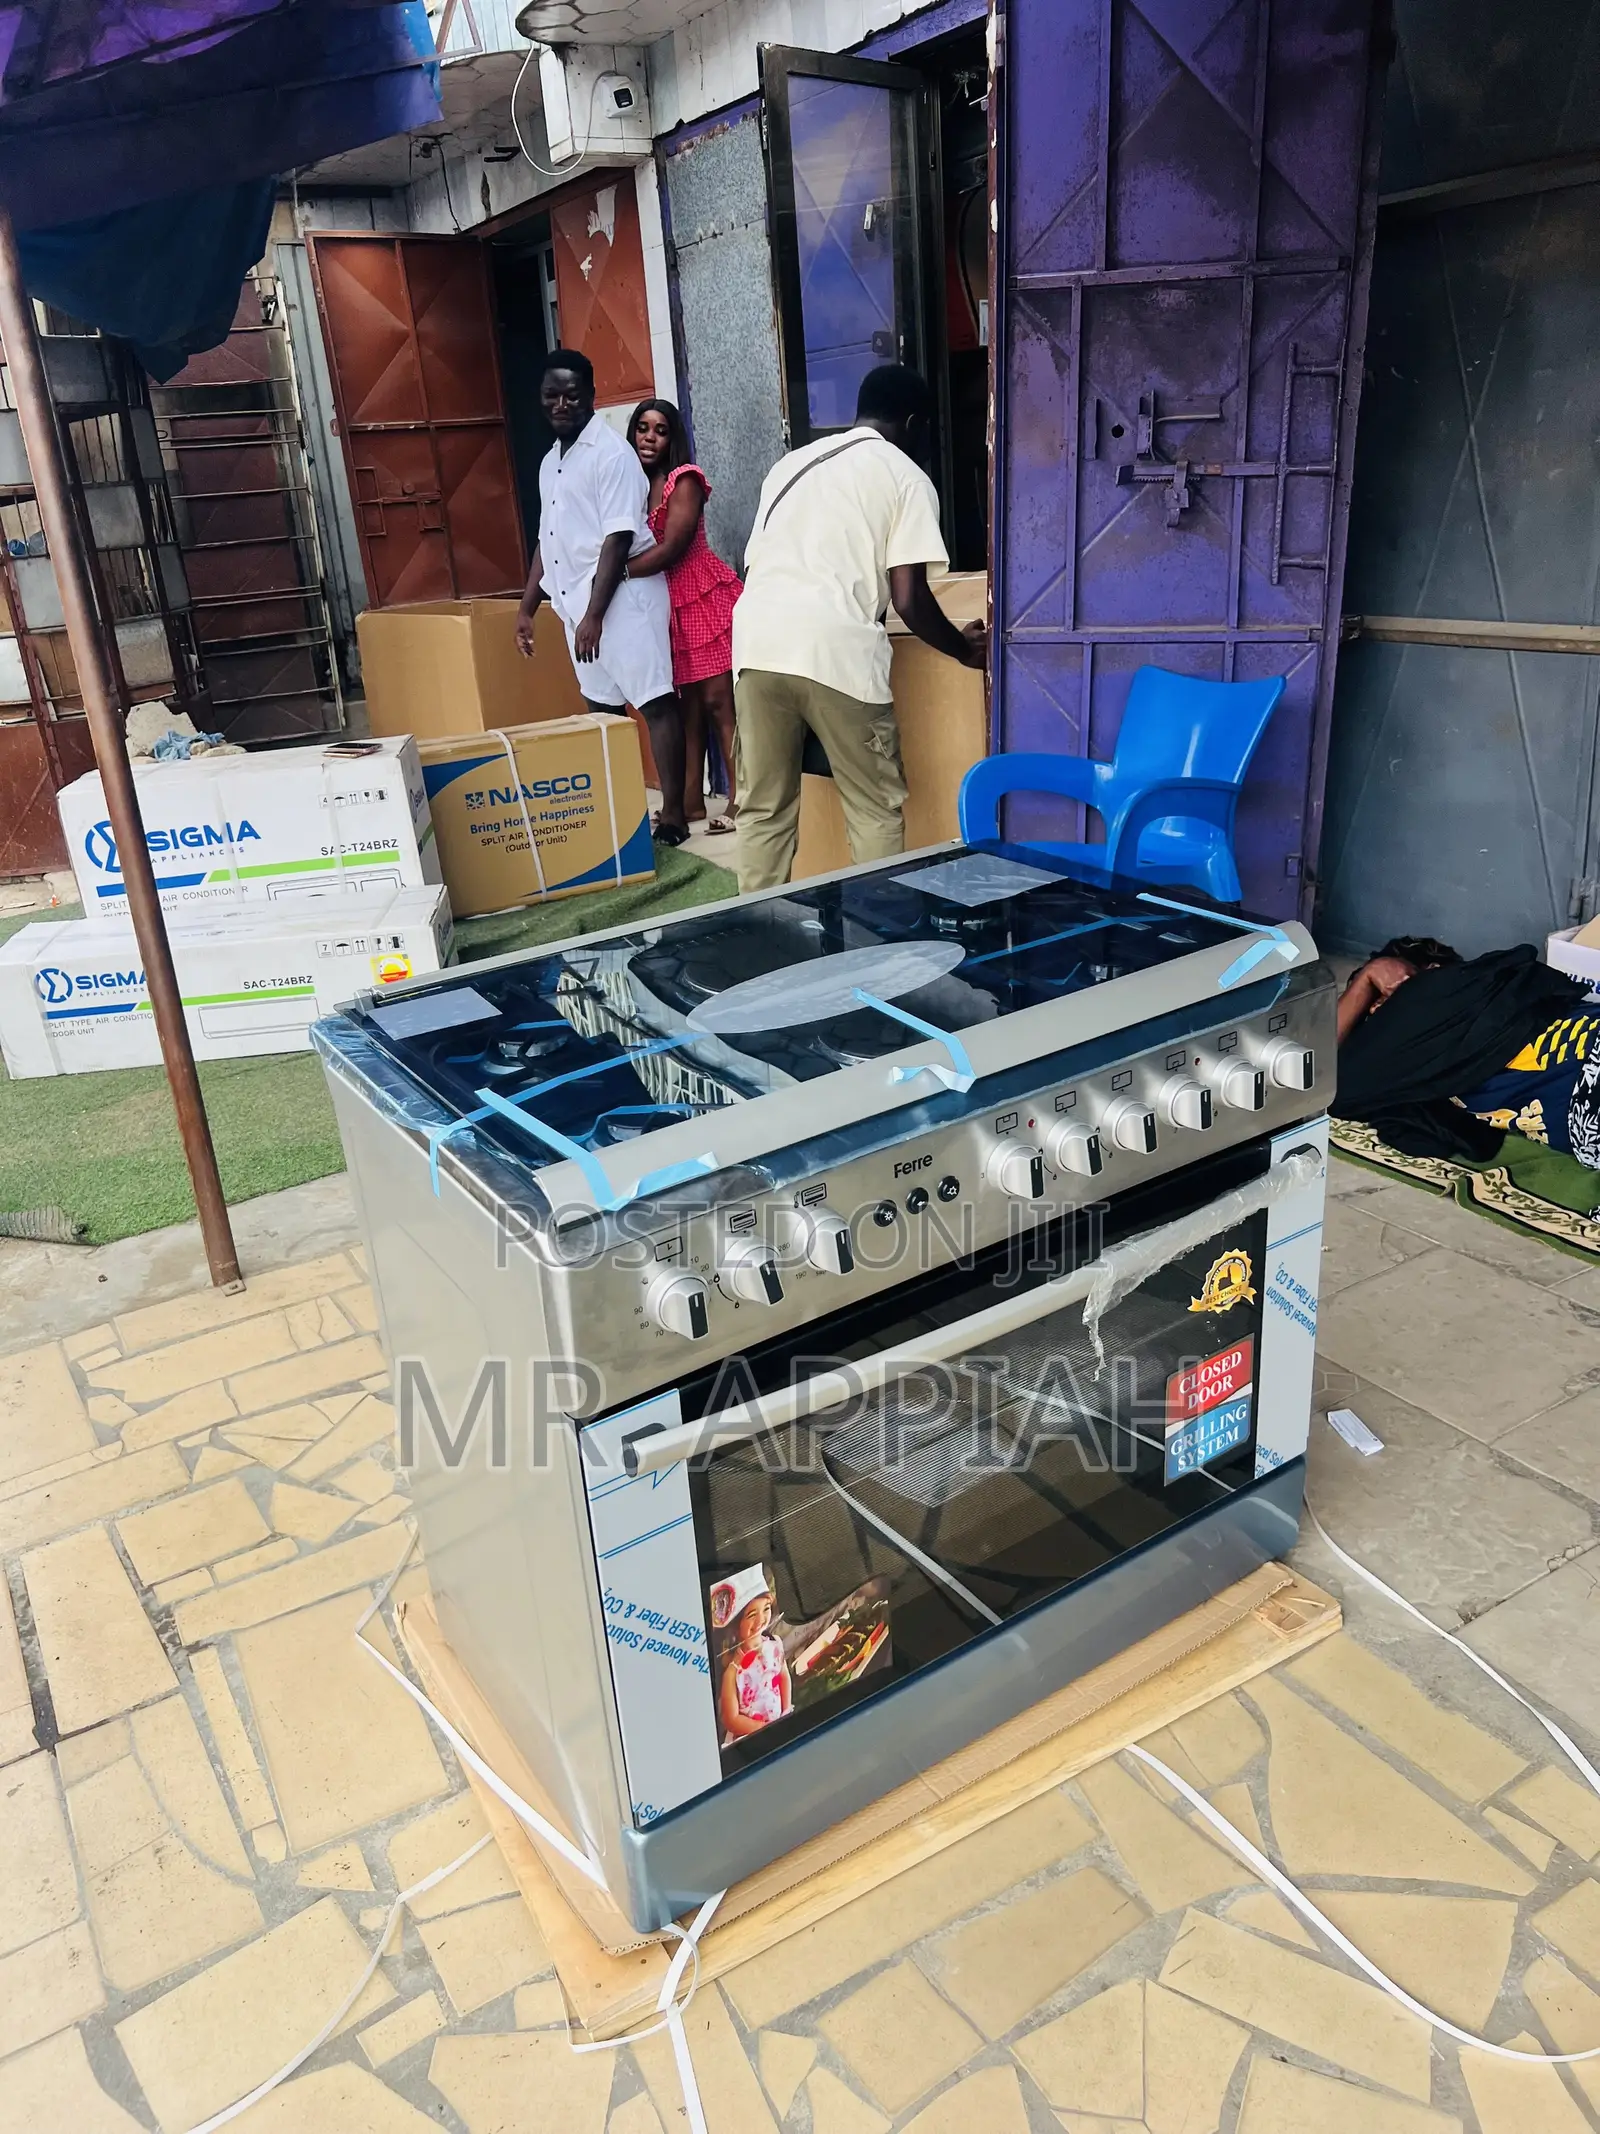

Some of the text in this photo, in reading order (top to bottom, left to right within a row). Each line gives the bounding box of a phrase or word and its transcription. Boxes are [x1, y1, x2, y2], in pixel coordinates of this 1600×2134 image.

[489, 773, 591, 806] NASCO
[550, 793, 592, 805] electronics
[470, 822, 501, 834] Bring
[540, 804, 595, 821] Happiness
[146, 820, 261, 852] SIGMA
[481, 820, 587, 846] SPLIT AIR ONDITIONER
[505, 834, 568, 854] (Outdor Unit)
[151, 847, 245, 863] APPLIANCS
[101, 886, 249, 911] SPLIT AIR CONDITIONR
[243, 975, 314, 990] SAC-T24BRZ
[79, 987, 145, 998] APPLIANCES
[70, 1019, 92, 1027] TYPE
[113, 1013, 153, 1023] CONDITIO
[48, 1027, 95, 1038] DOOR UNIT
[893, 1154, 934, 1179] Ferre
[690, 1255, 699, 1264] 10
[700, 1263, 710, 1272] 20
[1285, 1276, 1295, 1290] &
[1205, 1294, 1220, 1304] BEST
[1220, 1285, 1243, 1298] CHOICE
[1266, 1286, 1293, 1316] Solution
[1292, 1282, 1310, 1305] Fiber
[634, 1306, 644, 1315] 90
[640, 1321, 650, 1330] 80
[654, 1329, 664, 1338] 70
[1179, 1351, 1242, 1394] CLOSED
[1187, 1374, 1233, 1410] DOOR
[1170, 1403, 1247, 1456] GRILLING
[1177, 1425, 1240, 1472] SYSTEM
[1256, 1444, 1272, 1460] acel
[624, 1602, 637, 1619] &
[636, 1608, 671, 1631] Fiber
[668, 1619, 707, 1645] ASER
[639, 1637, 692, 1666] Novacel
[692, 1655, 709, 1673] The
